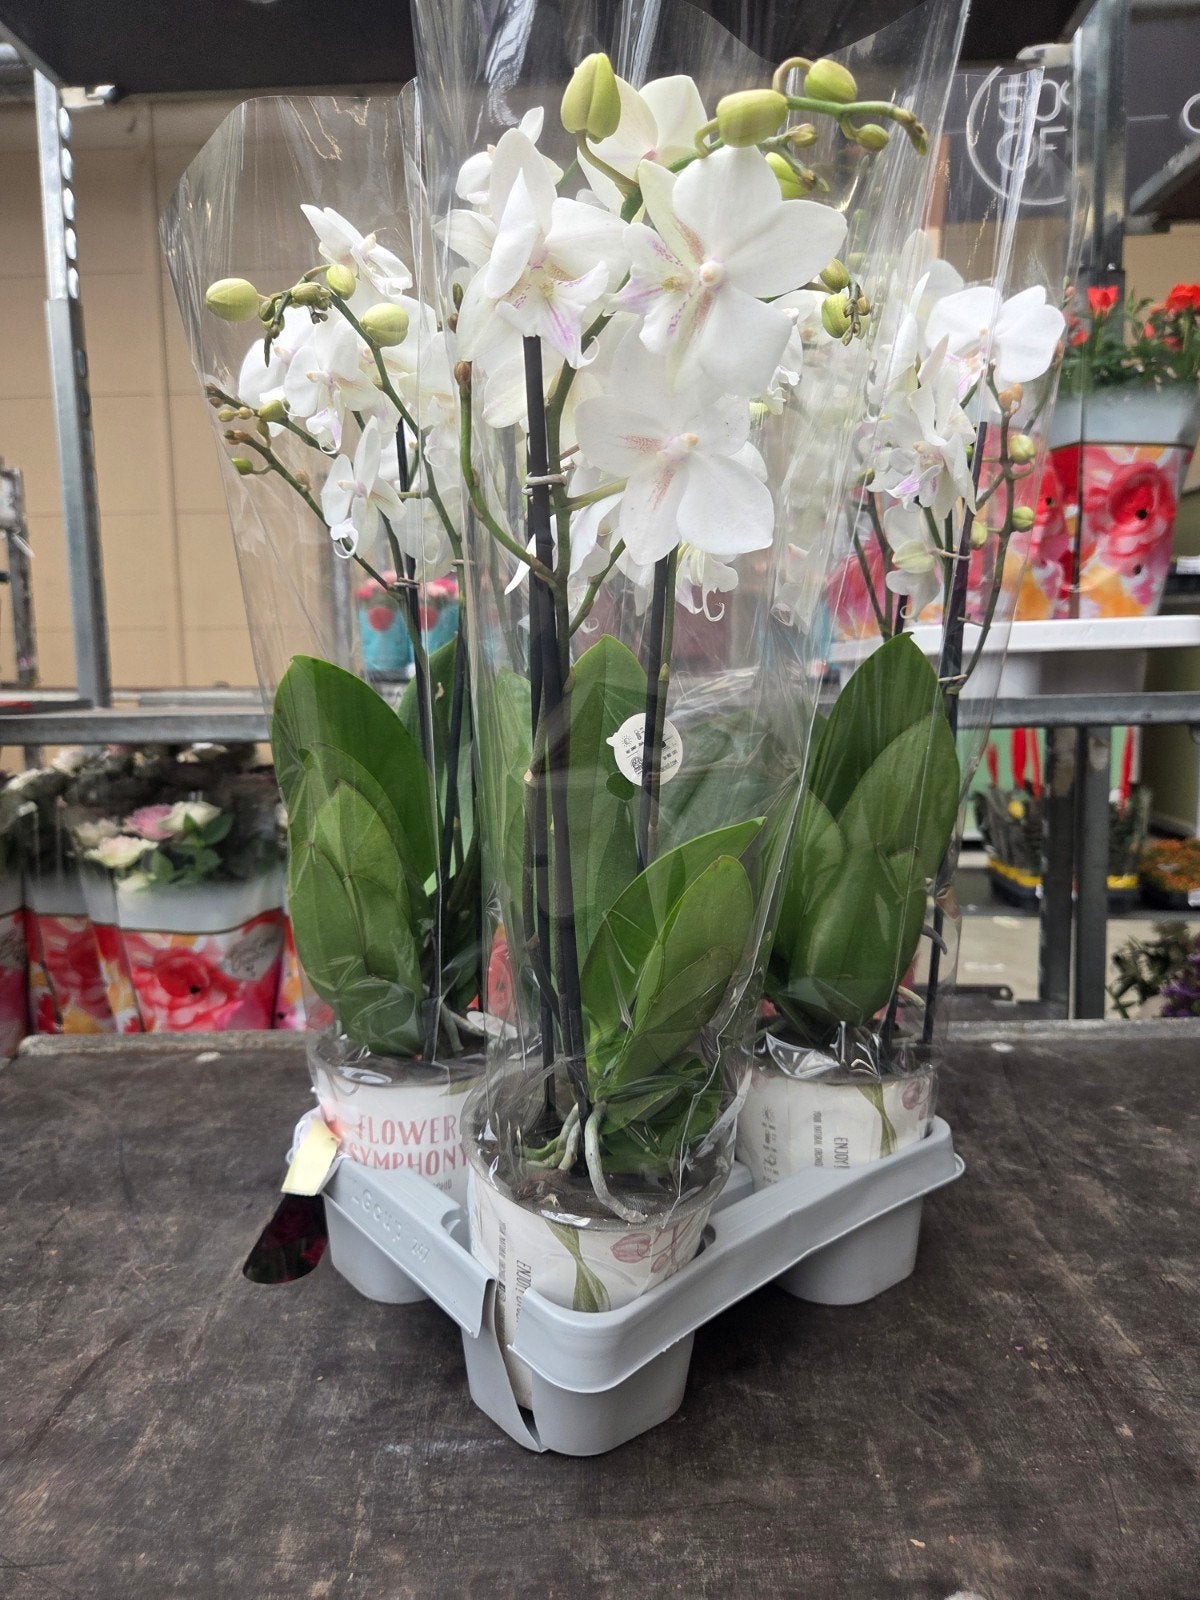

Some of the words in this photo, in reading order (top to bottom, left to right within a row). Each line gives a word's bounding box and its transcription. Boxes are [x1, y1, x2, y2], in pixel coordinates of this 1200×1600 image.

[357, 1114, 457, 1146] FLOWER
[348, 1142, 469, 1176] SYMPHONY
[833, 1136, 850, 1169] ENJOY!
